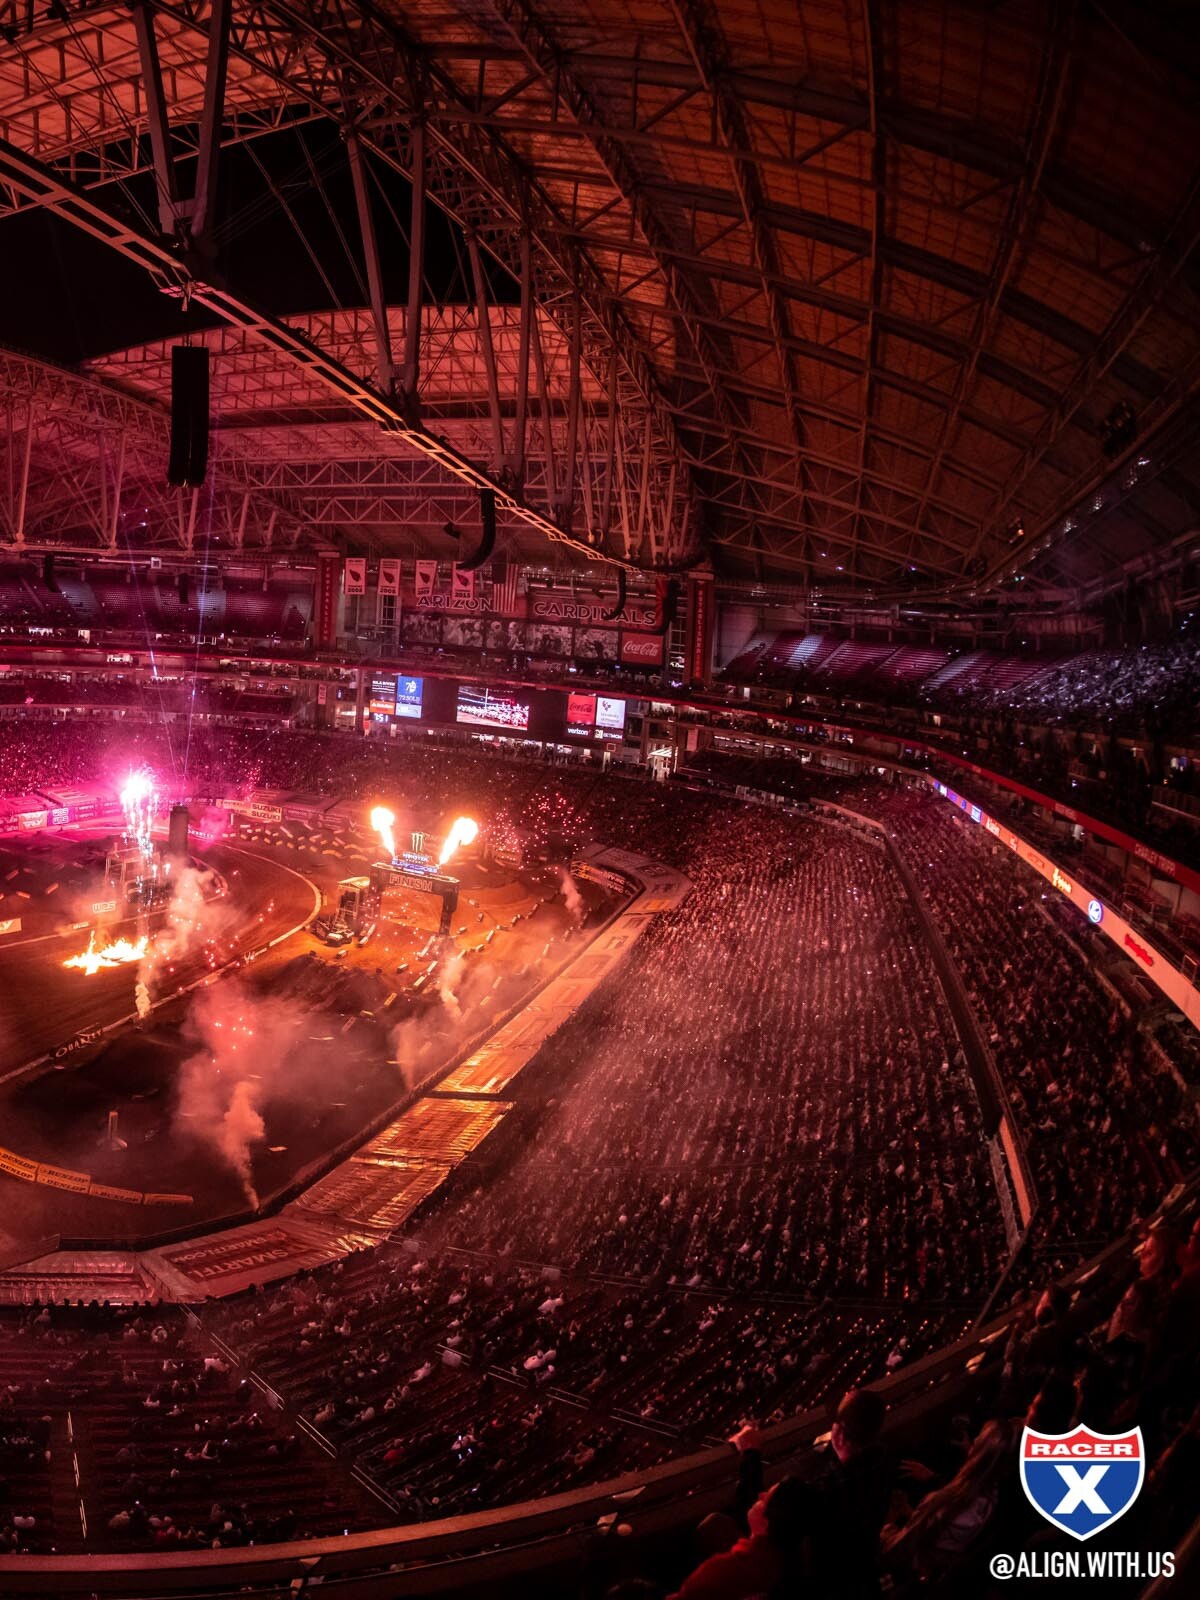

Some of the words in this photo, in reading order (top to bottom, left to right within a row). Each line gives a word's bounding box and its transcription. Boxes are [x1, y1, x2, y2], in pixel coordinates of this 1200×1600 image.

[416, 594, 494, 613] ARIZON
[534, 602, 657, 626] CARDINALS
[568, 728, 588, 736] verizon
[251, 810, 280, 820] SUZUKI
[252, 803, 280, 813] SUZUKI
[390, 873, 433, 892] FINISH
[2, 1153, 36, 1170] DUNLOP
[0, 1163, 33, 1179] DUNLOP
[48, 1170, 88, 1183] DUNLOP
[47, 1180, 86, 1192] DUNLOP
